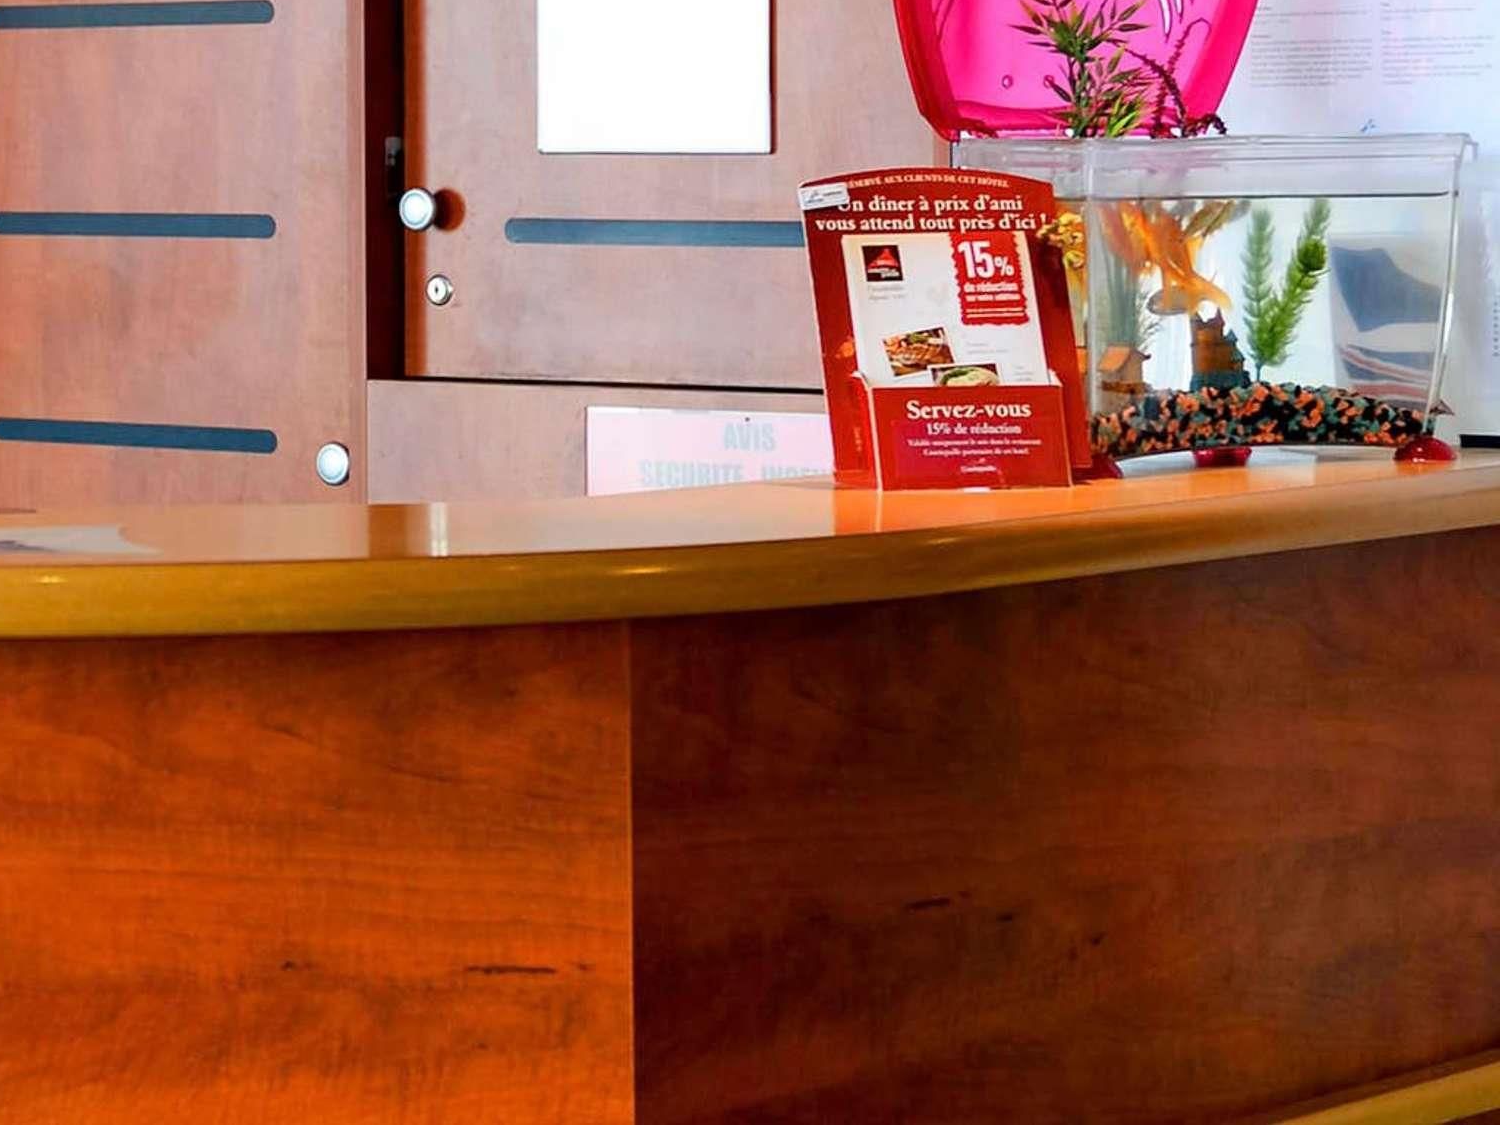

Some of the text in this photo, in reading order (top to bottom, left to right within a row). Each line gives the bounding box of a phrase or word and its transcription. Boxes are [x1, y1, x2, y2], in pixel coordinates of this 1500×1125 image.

[869, 195, 915, 211] dîner
[919, 195, 930, 211] à
[934, 195, 970, 215] prix
[974, 194, 1023, 211] d'ami
[815, 219, 856, 231] vous
[860, 213, 915, 230] attend
[920, 217, 955, 229] tout
[959, 215, 995, 233] près
[999, 213, 1036, 229] d'ici
[958, 241, 1015, 279] 15%
[906, 400, 1032, 419] Servez-vous
[723, 423, 776, 451] AVIS
[927, 422, 951, 435] 15%
[954, 423, 968, 434] de
